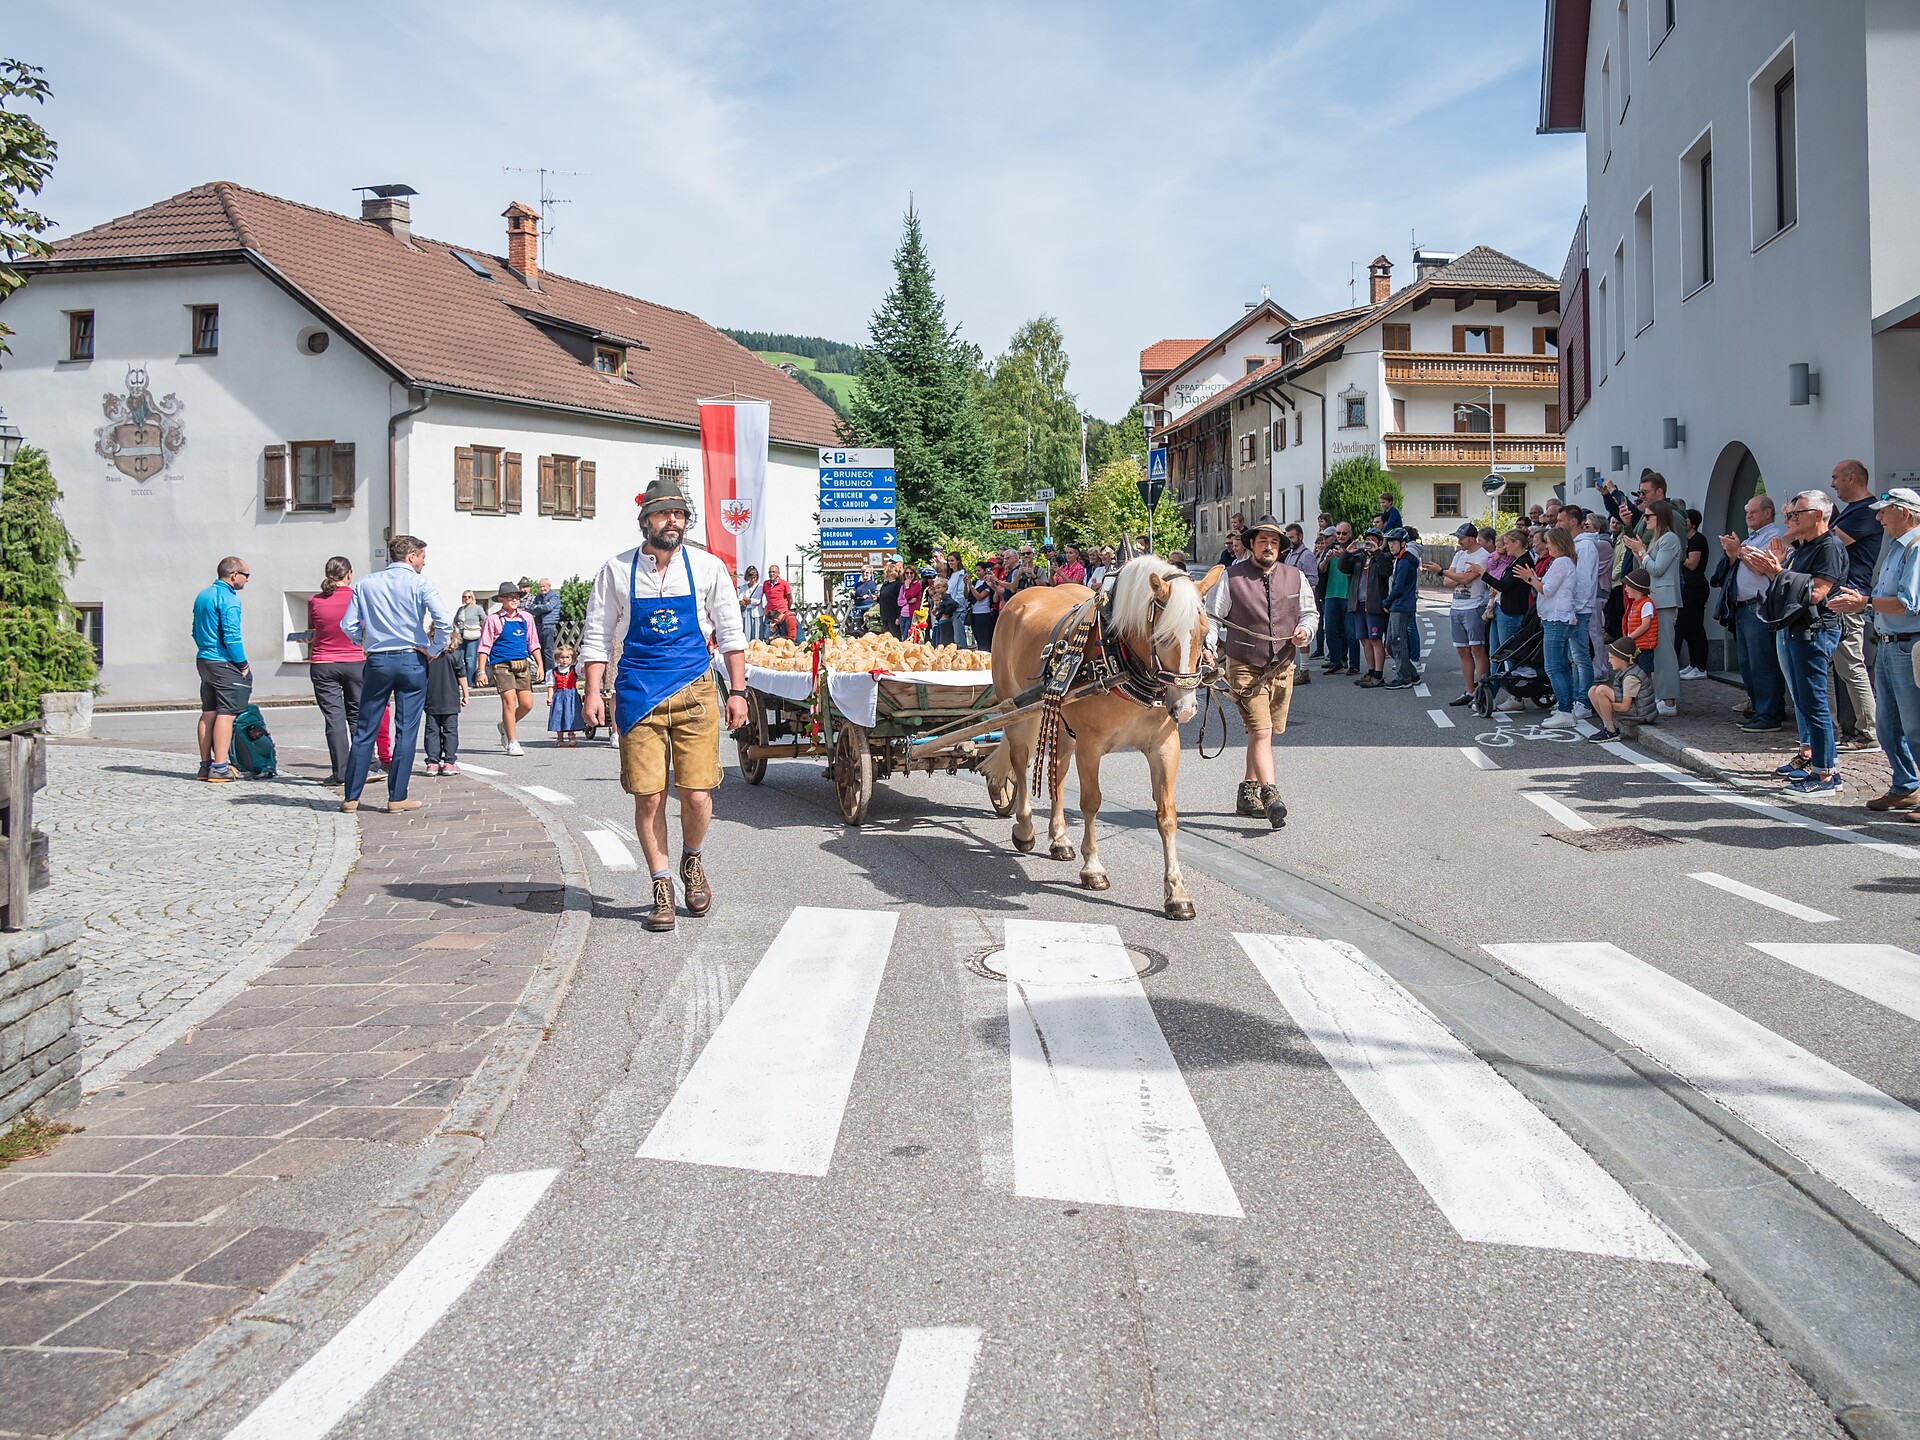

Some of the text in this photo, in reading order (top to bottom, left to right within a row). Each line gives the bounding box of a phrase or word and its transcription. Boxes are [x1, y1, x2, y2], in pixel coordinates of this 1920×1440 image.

[833, 470, 874, 478] BRUNECK
[833, 479, 872, 487] BRUNICO
[883, 475, 893, 483] 14
[833, 491, 863, 499] INNICHEN
[833, 500, 869, 508] S. CANDIDO
[882, 496, 893, 504] 22
